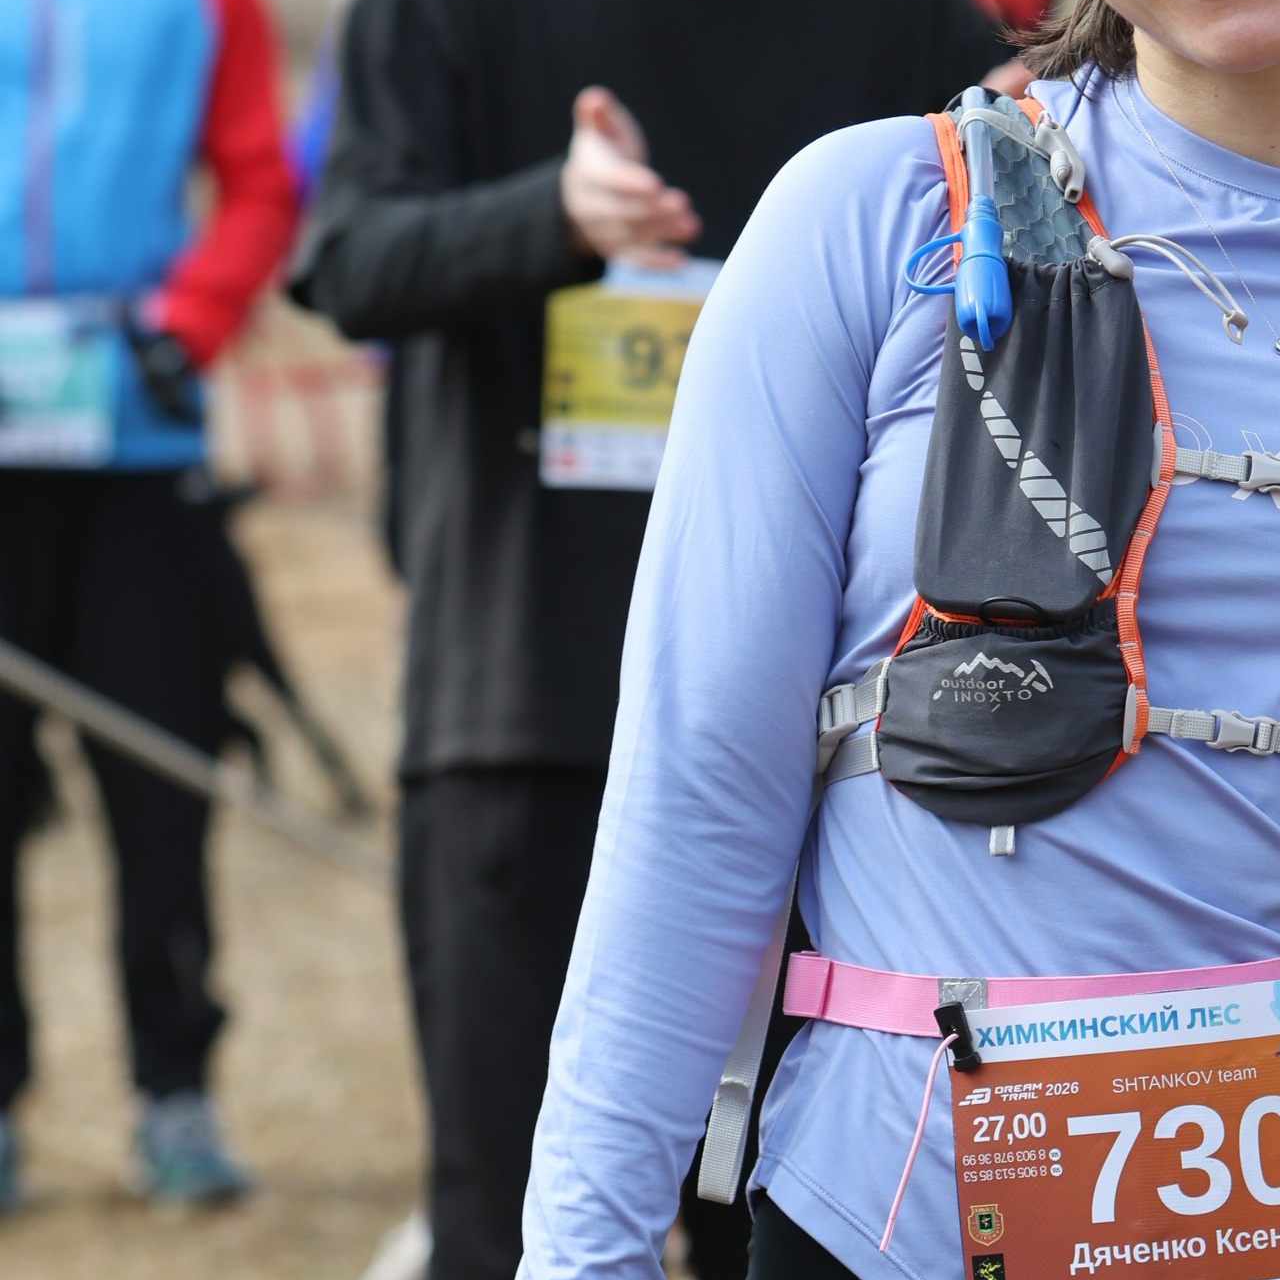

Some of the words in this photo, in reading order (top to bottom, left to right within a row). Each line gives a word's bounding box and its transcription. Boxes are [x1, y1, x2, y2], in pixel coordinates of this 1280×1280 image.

[941, 678, 1005, 690] outdoor
[975, 1005, 1179, 1048] ХИМКИНСКИЙ
[1186, 1003, 1241, 1029] ЛЕС
[1112, 1069, 1213, 1094] SHTANKOV
[1217, 1066, 1257, 1084] team
[994, 1082, 1043, 1095] DREAM
[1044, 1081, 1079, 1096] 2026
[1000, 1092, 1038, 1102] TRAIL
[972, 1112, 1047, 1145] 27,00
[962, 1154, 977, 1166] 99
[978, 1153, 992, 1165] 36
[994, 1151, 1014, 1164] 978
[1016, 1149, 1036, 1162] 903
[1038, 1148, 1046, 1160] 8
[963, 1171, 977, 1183] 53
[979, 1169, 993, 1182] 85
[995, 1168, 1015, 1180] 513
[1017, 1166, 1037, 1179] 905
[1039, 1165, 1047, 1176] 8
[1069, 1236, 1206, 1276] Дяченко
